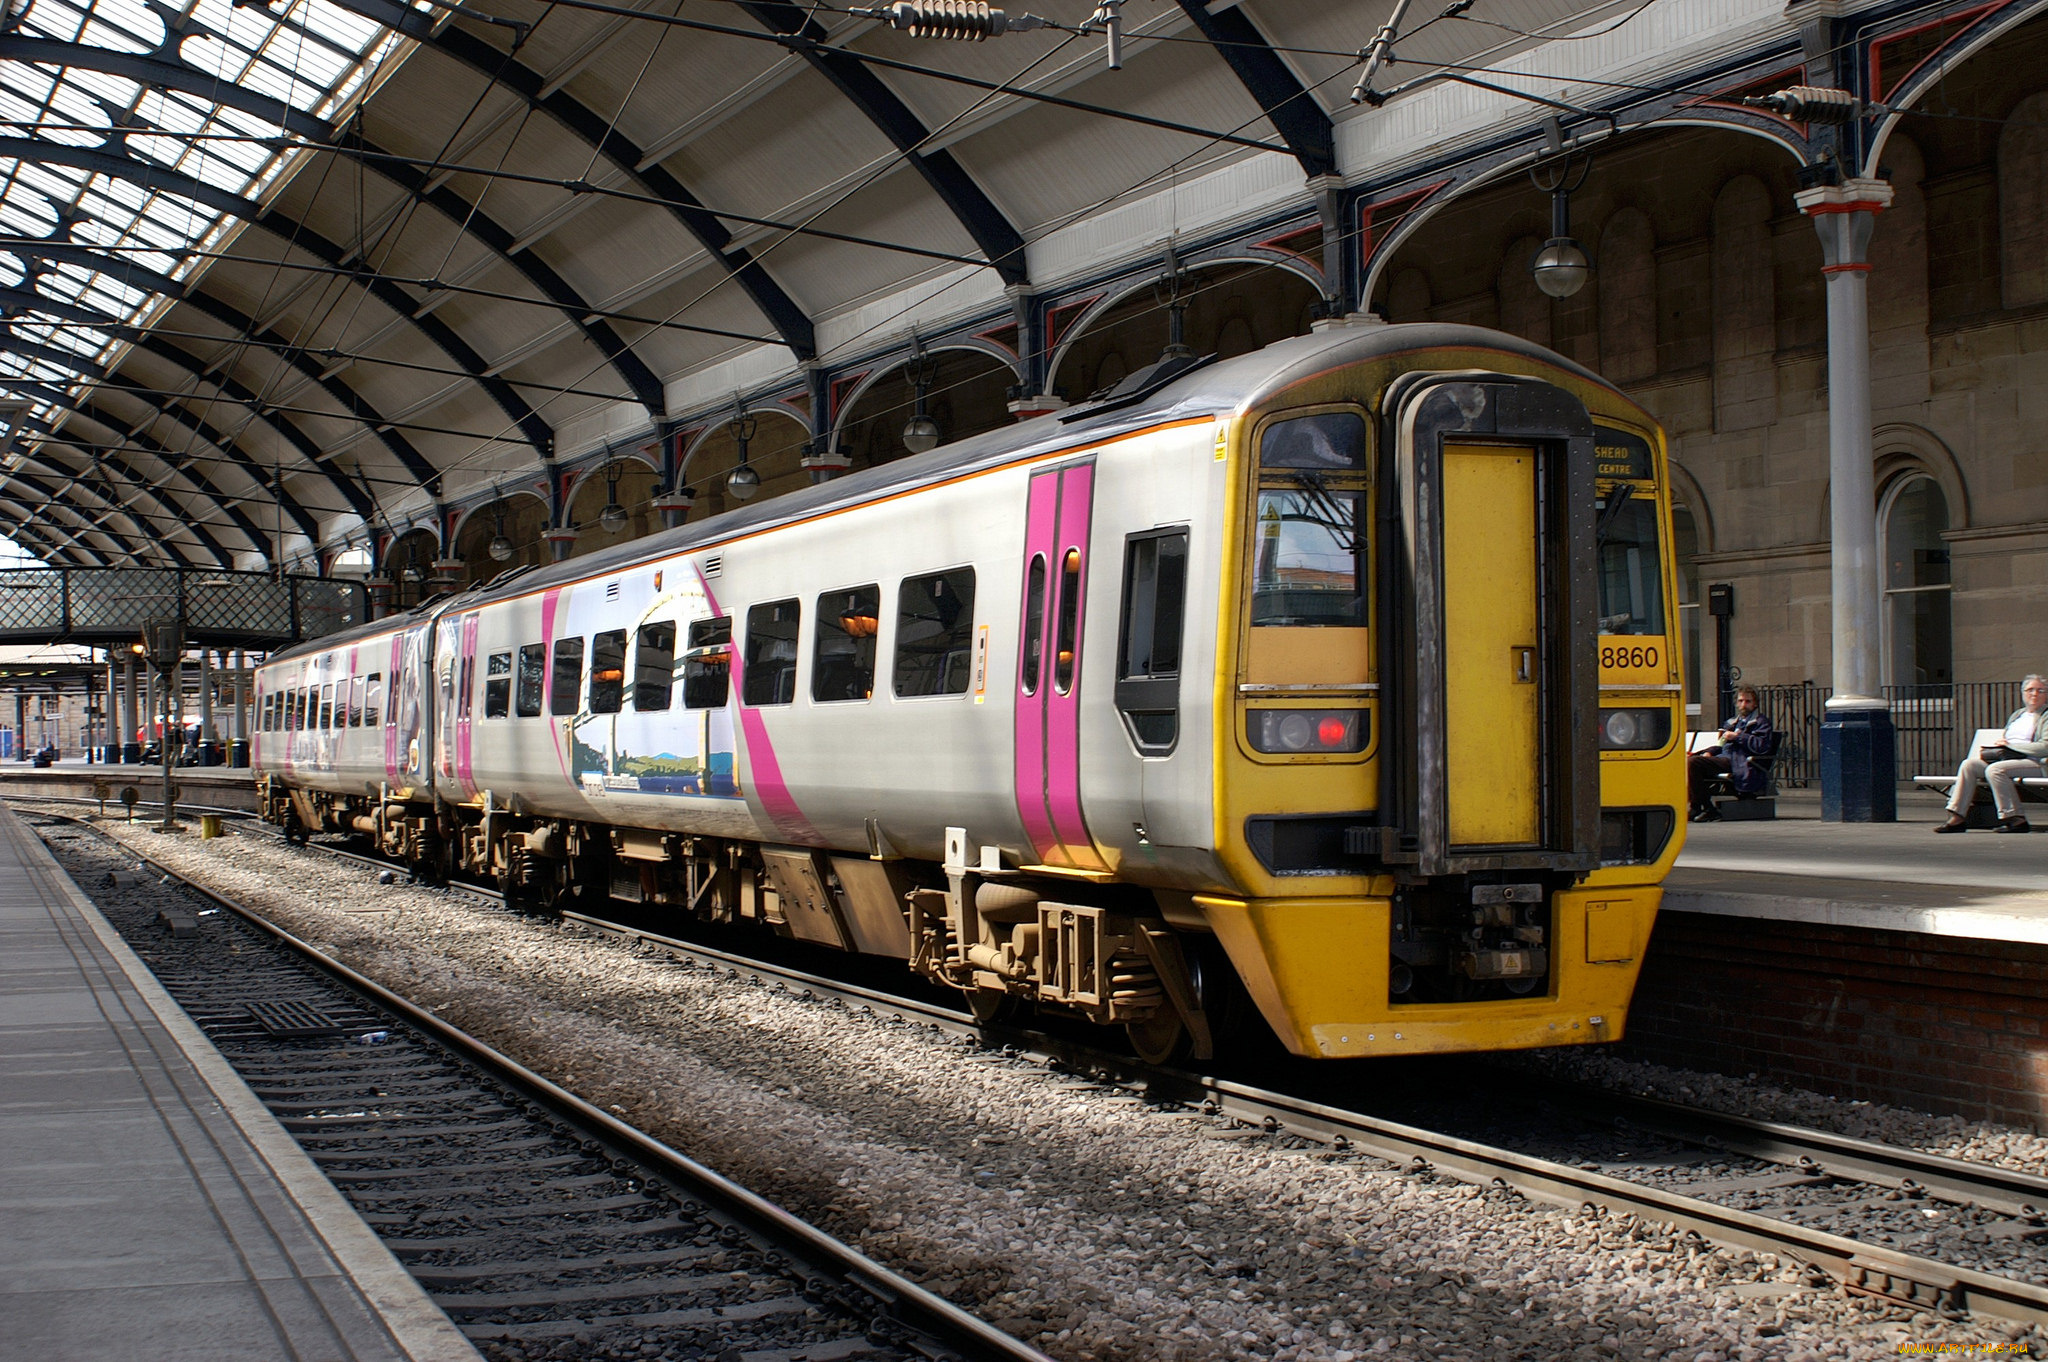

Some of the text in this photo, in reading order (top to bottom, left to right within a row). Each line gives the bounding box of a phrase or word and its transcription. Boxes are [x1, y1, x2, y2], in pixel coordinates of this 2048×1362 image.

[1594, 446, 1628, 458] SHEAD
[1598, 464, 1632, 474] CENTRE
[1601, 646, 1658, 668] 8860
